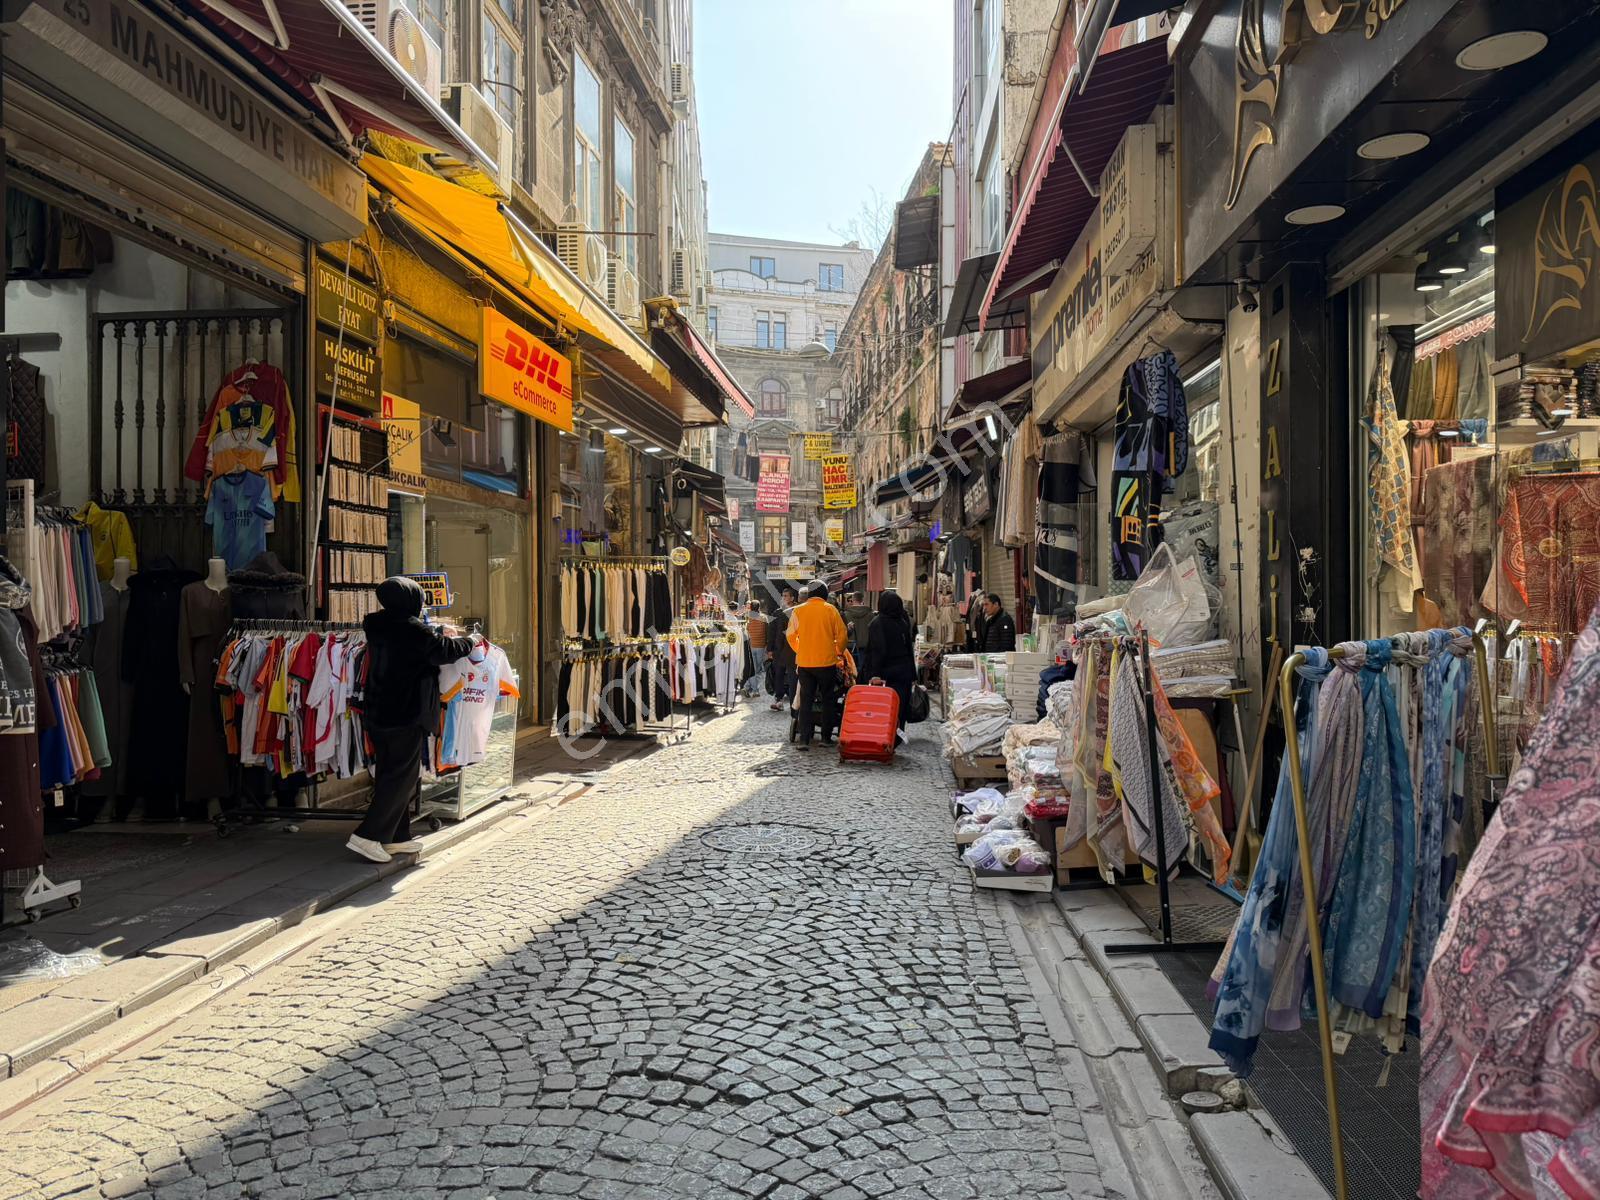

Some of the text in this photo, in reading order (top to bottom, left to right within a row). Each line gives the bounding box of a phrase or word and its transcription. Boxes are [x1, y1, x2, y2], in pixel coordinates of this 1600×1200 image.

[63, 0, 358, 212] 25 MAHMUDİYE HAN 27
[1105, 142, 1126, 195] AKSAN
[357, 288, 377, 313] UCUZ
[1085, 304, 1104, 340] home
[504, 328, 563, 394] DHL
[513, 380, 557, 415] eCommerce
[823, 456, 848, 465] YUNU
[824, 475, 848, 484] UMR
